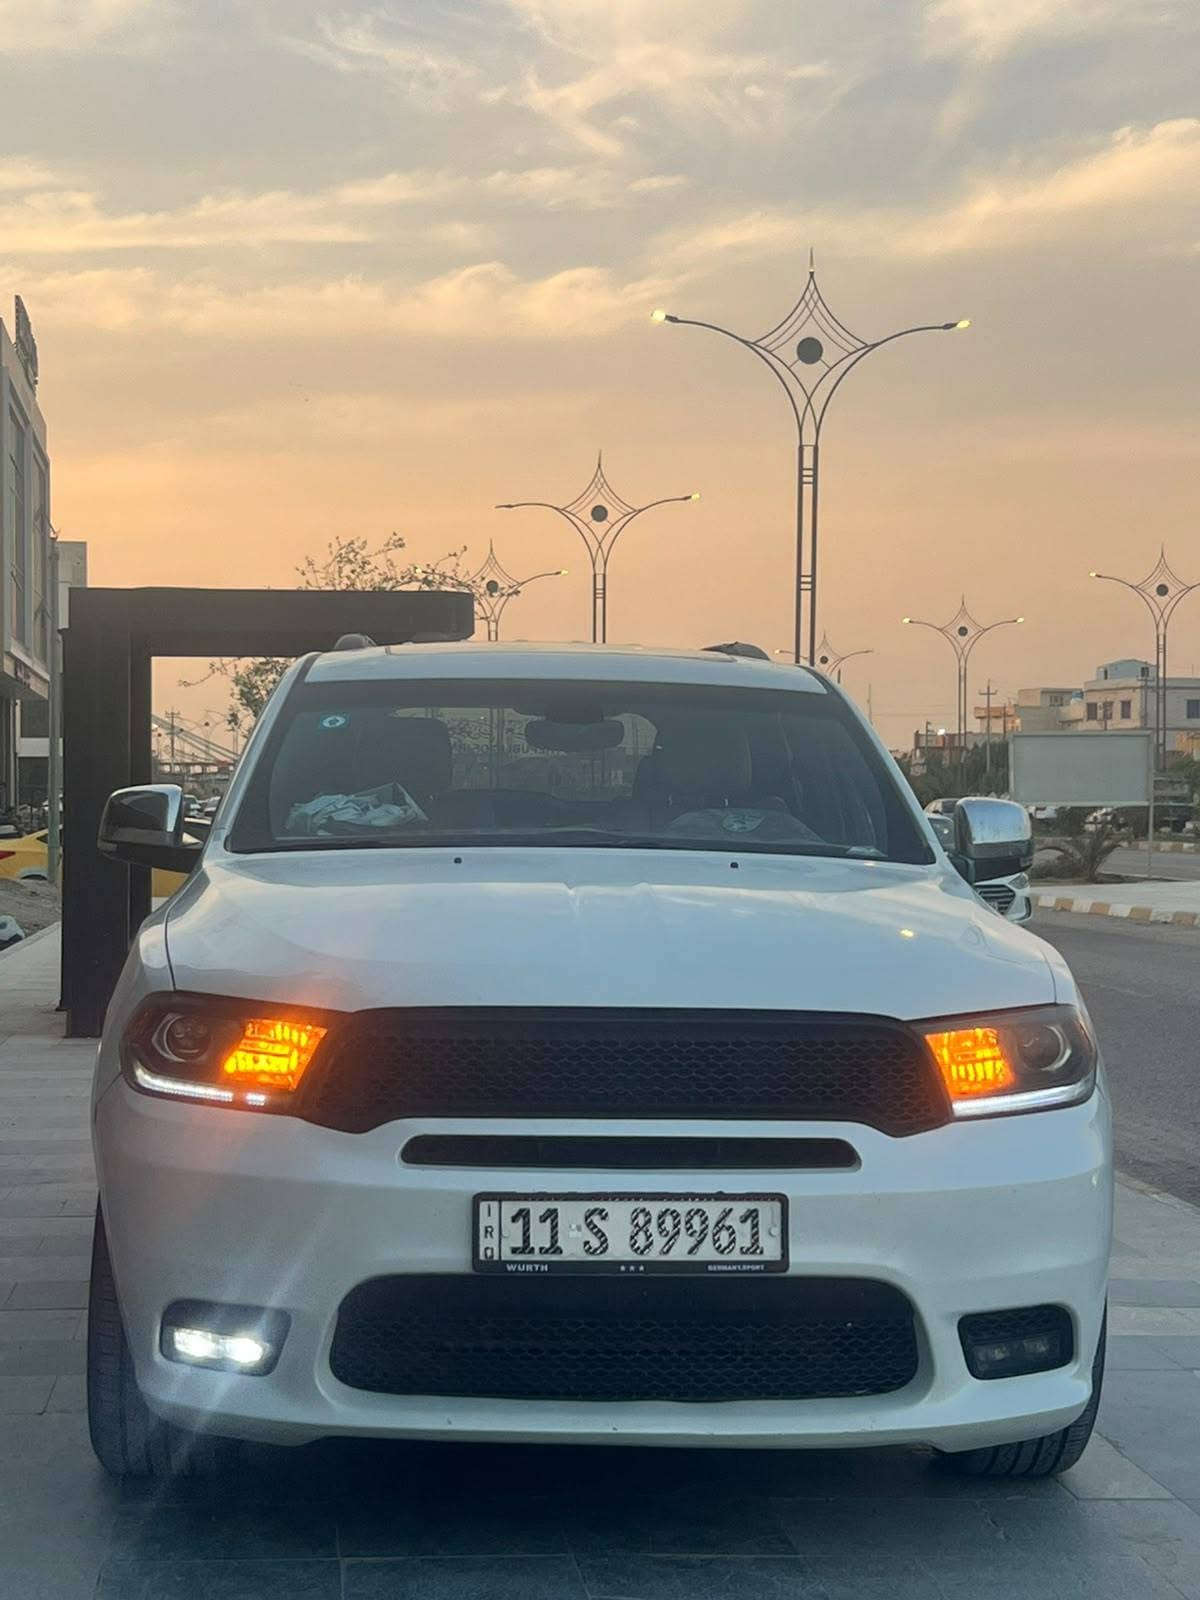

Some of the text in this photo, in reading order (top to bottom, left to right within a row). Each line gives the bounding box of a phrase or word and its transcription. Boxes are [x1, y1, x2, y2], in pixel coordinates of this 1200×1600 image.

[511, 1207, 764, 1256] 11 S 89961
